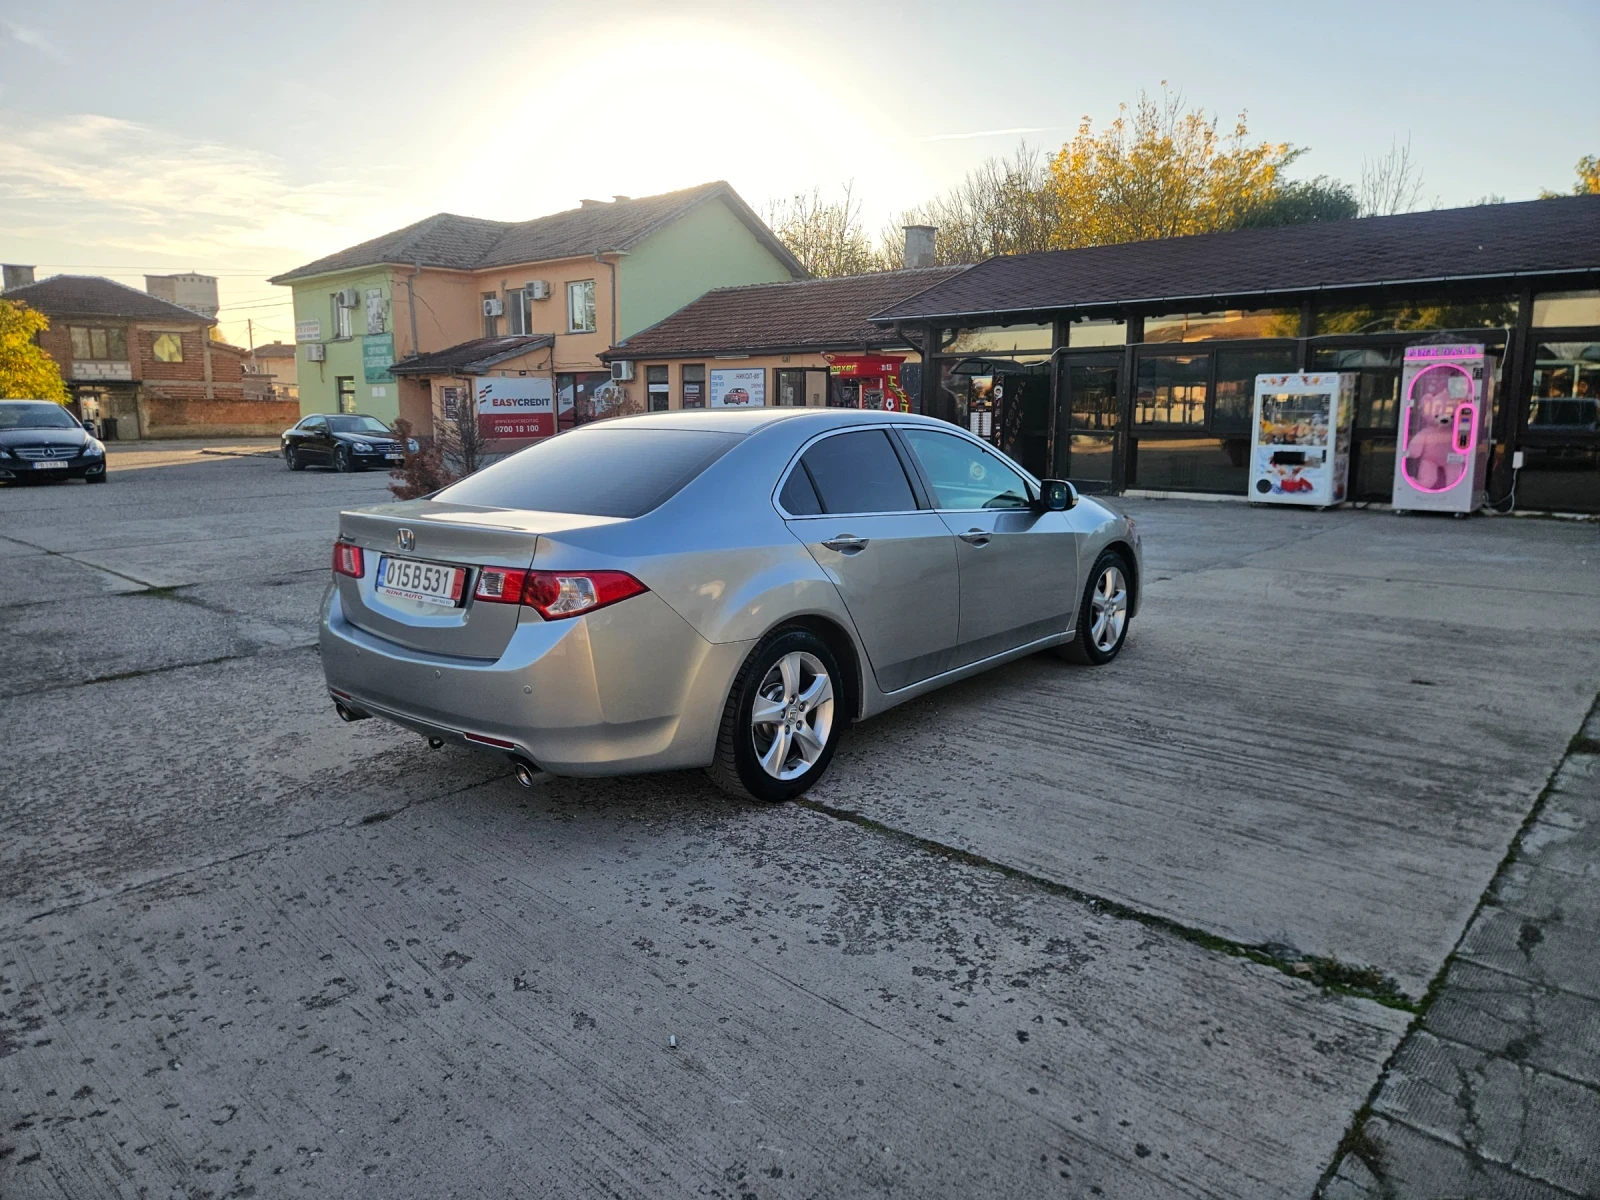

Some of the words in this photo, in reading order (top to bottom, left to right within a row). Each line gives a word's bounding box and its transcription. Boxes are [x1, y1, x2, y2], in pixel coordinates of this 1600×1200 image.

[492, 398, 551, 407] EASYCREDIT
[494, 425, 513, 433] 0700
[515, 425, 524, 433] 18
[526, 424, 539, 432] 100
[386, 561, 449, 594] 015B531
[404, 592, 423, 600] AUTO
